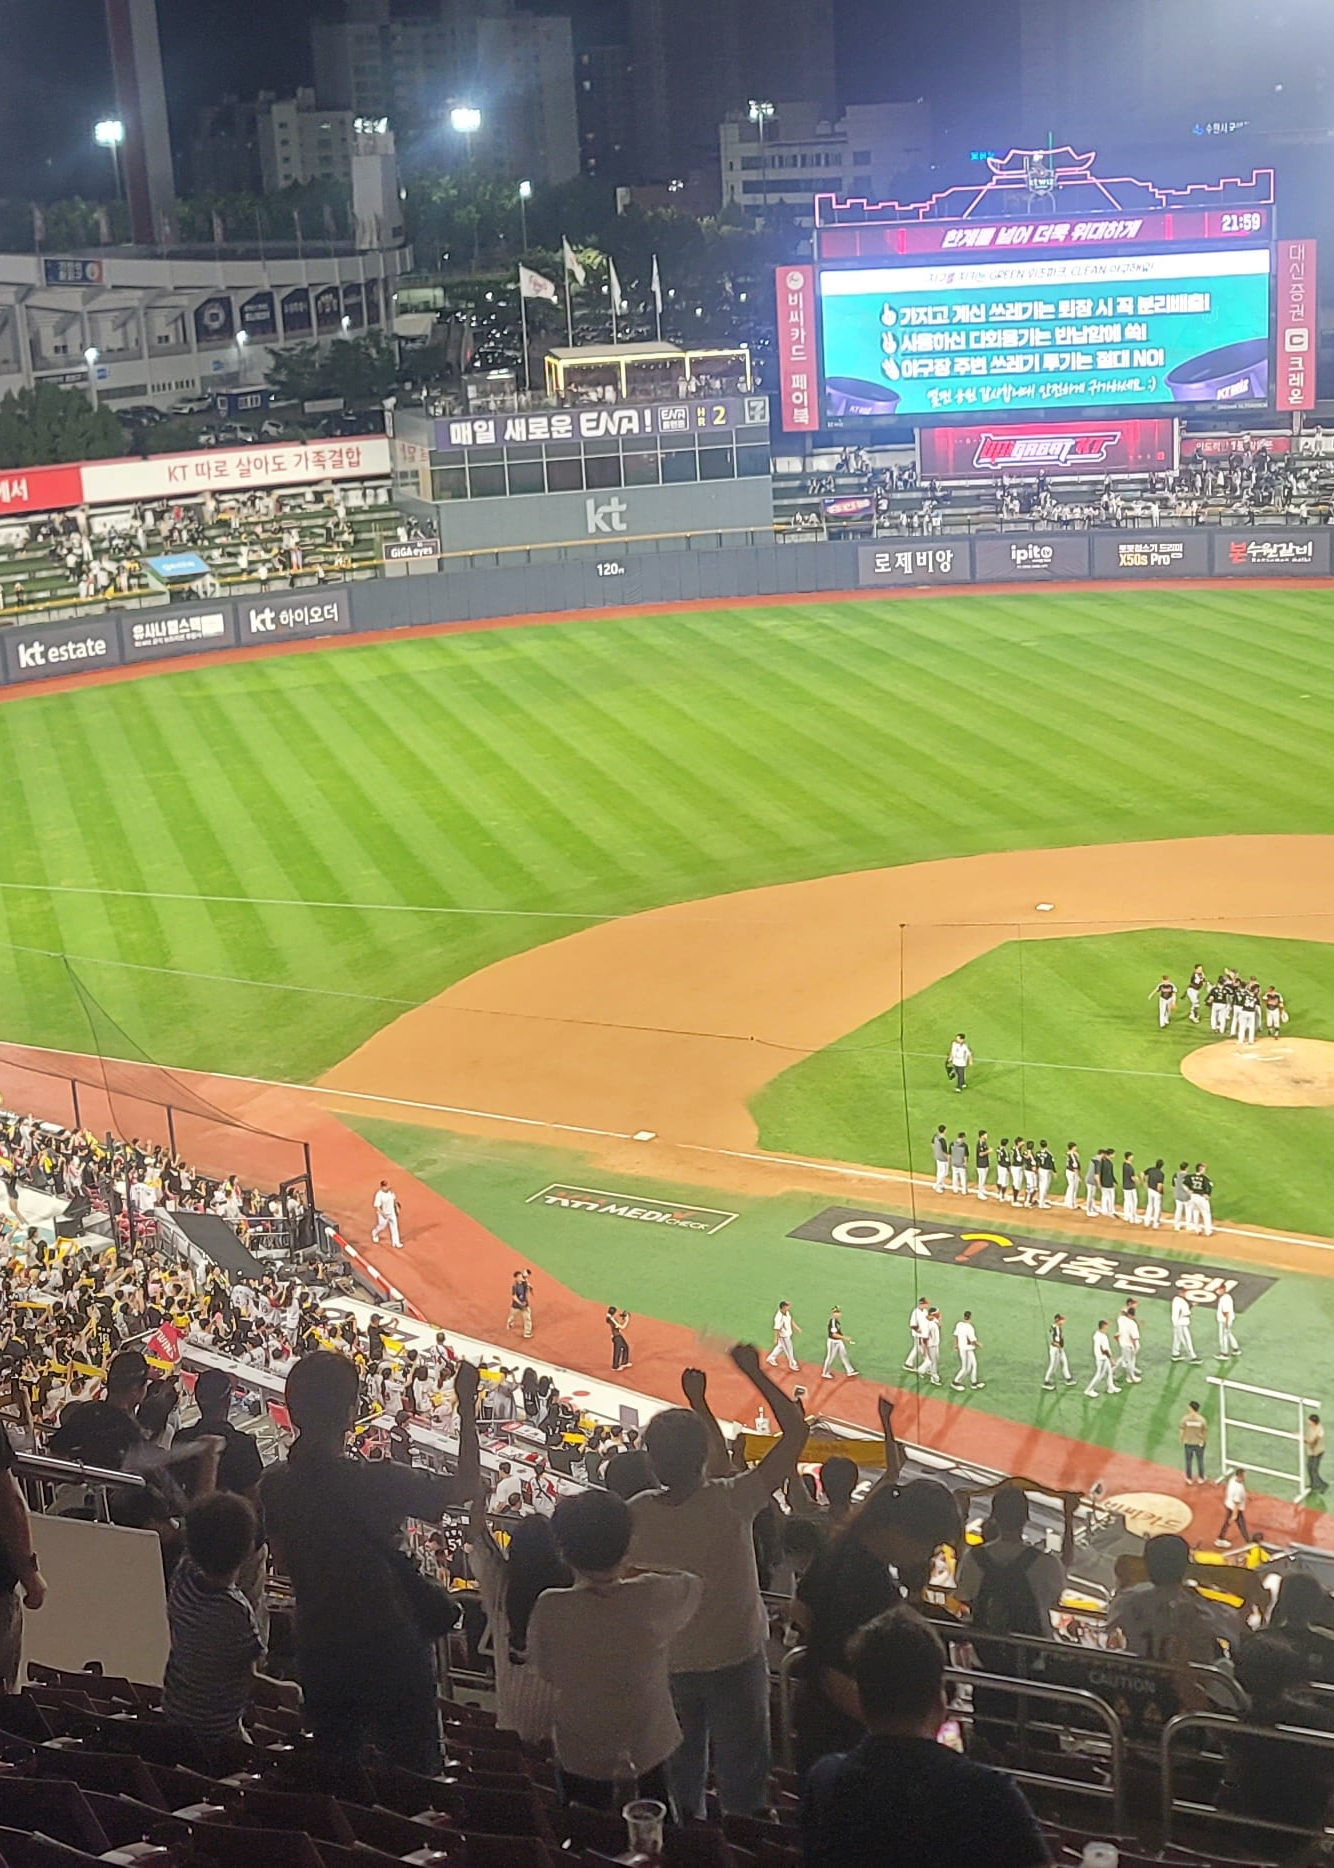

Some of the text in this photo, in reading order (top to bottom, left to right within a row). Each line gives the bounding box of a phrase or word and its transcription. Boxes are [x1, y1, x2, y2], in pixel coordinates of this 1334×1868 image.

[942, 219, 1142, 249] 한계를 넘어 더욱 위대하게
[1221, 213, 1261, 233] 21:59
[989, 269, 1025, 281] GREEN
[1070, 265, 1106, 277] CLEAN
[900, 293, 1211, 326] 가지고 계신 쓰레기는 퇴장 시 꼭 분리배출!
[1286, 243, 1305, 405] 대신증권 크레온
[901, 323, 1148, 353] 사용하신 다회용기는 반납함에 쏙!
[788, 291, 809, 425] 비씨카드 페이북
[901, 348, 1165, 379] 야구장 주변 쓰레기 투기는 절대 NO!
[1038, 379, 1085, 399] 안전하게
[661, 408, 685, 420] ENA
[713, 405, 726, 425] 2
[450, 420, 496, 446] 매일
[504, 414, 572, 442] 새로운
[167, 446, 362, 483] KT 따로 살아도 가족결합
[586, 496, 628, 534] kt
[874, 548, 954, 575] 로제비앙
[1119, 553, 1170, 567] X50s Pro
[249, 603, 339, 633] kt 하이오더
[19, 640, 46, 668] kt
[48, 636, 106, 664] estate
[831, 1218, 1237, 1307] OK 저축은행
[1088, 1670, 1157, 1694] CAUTION
